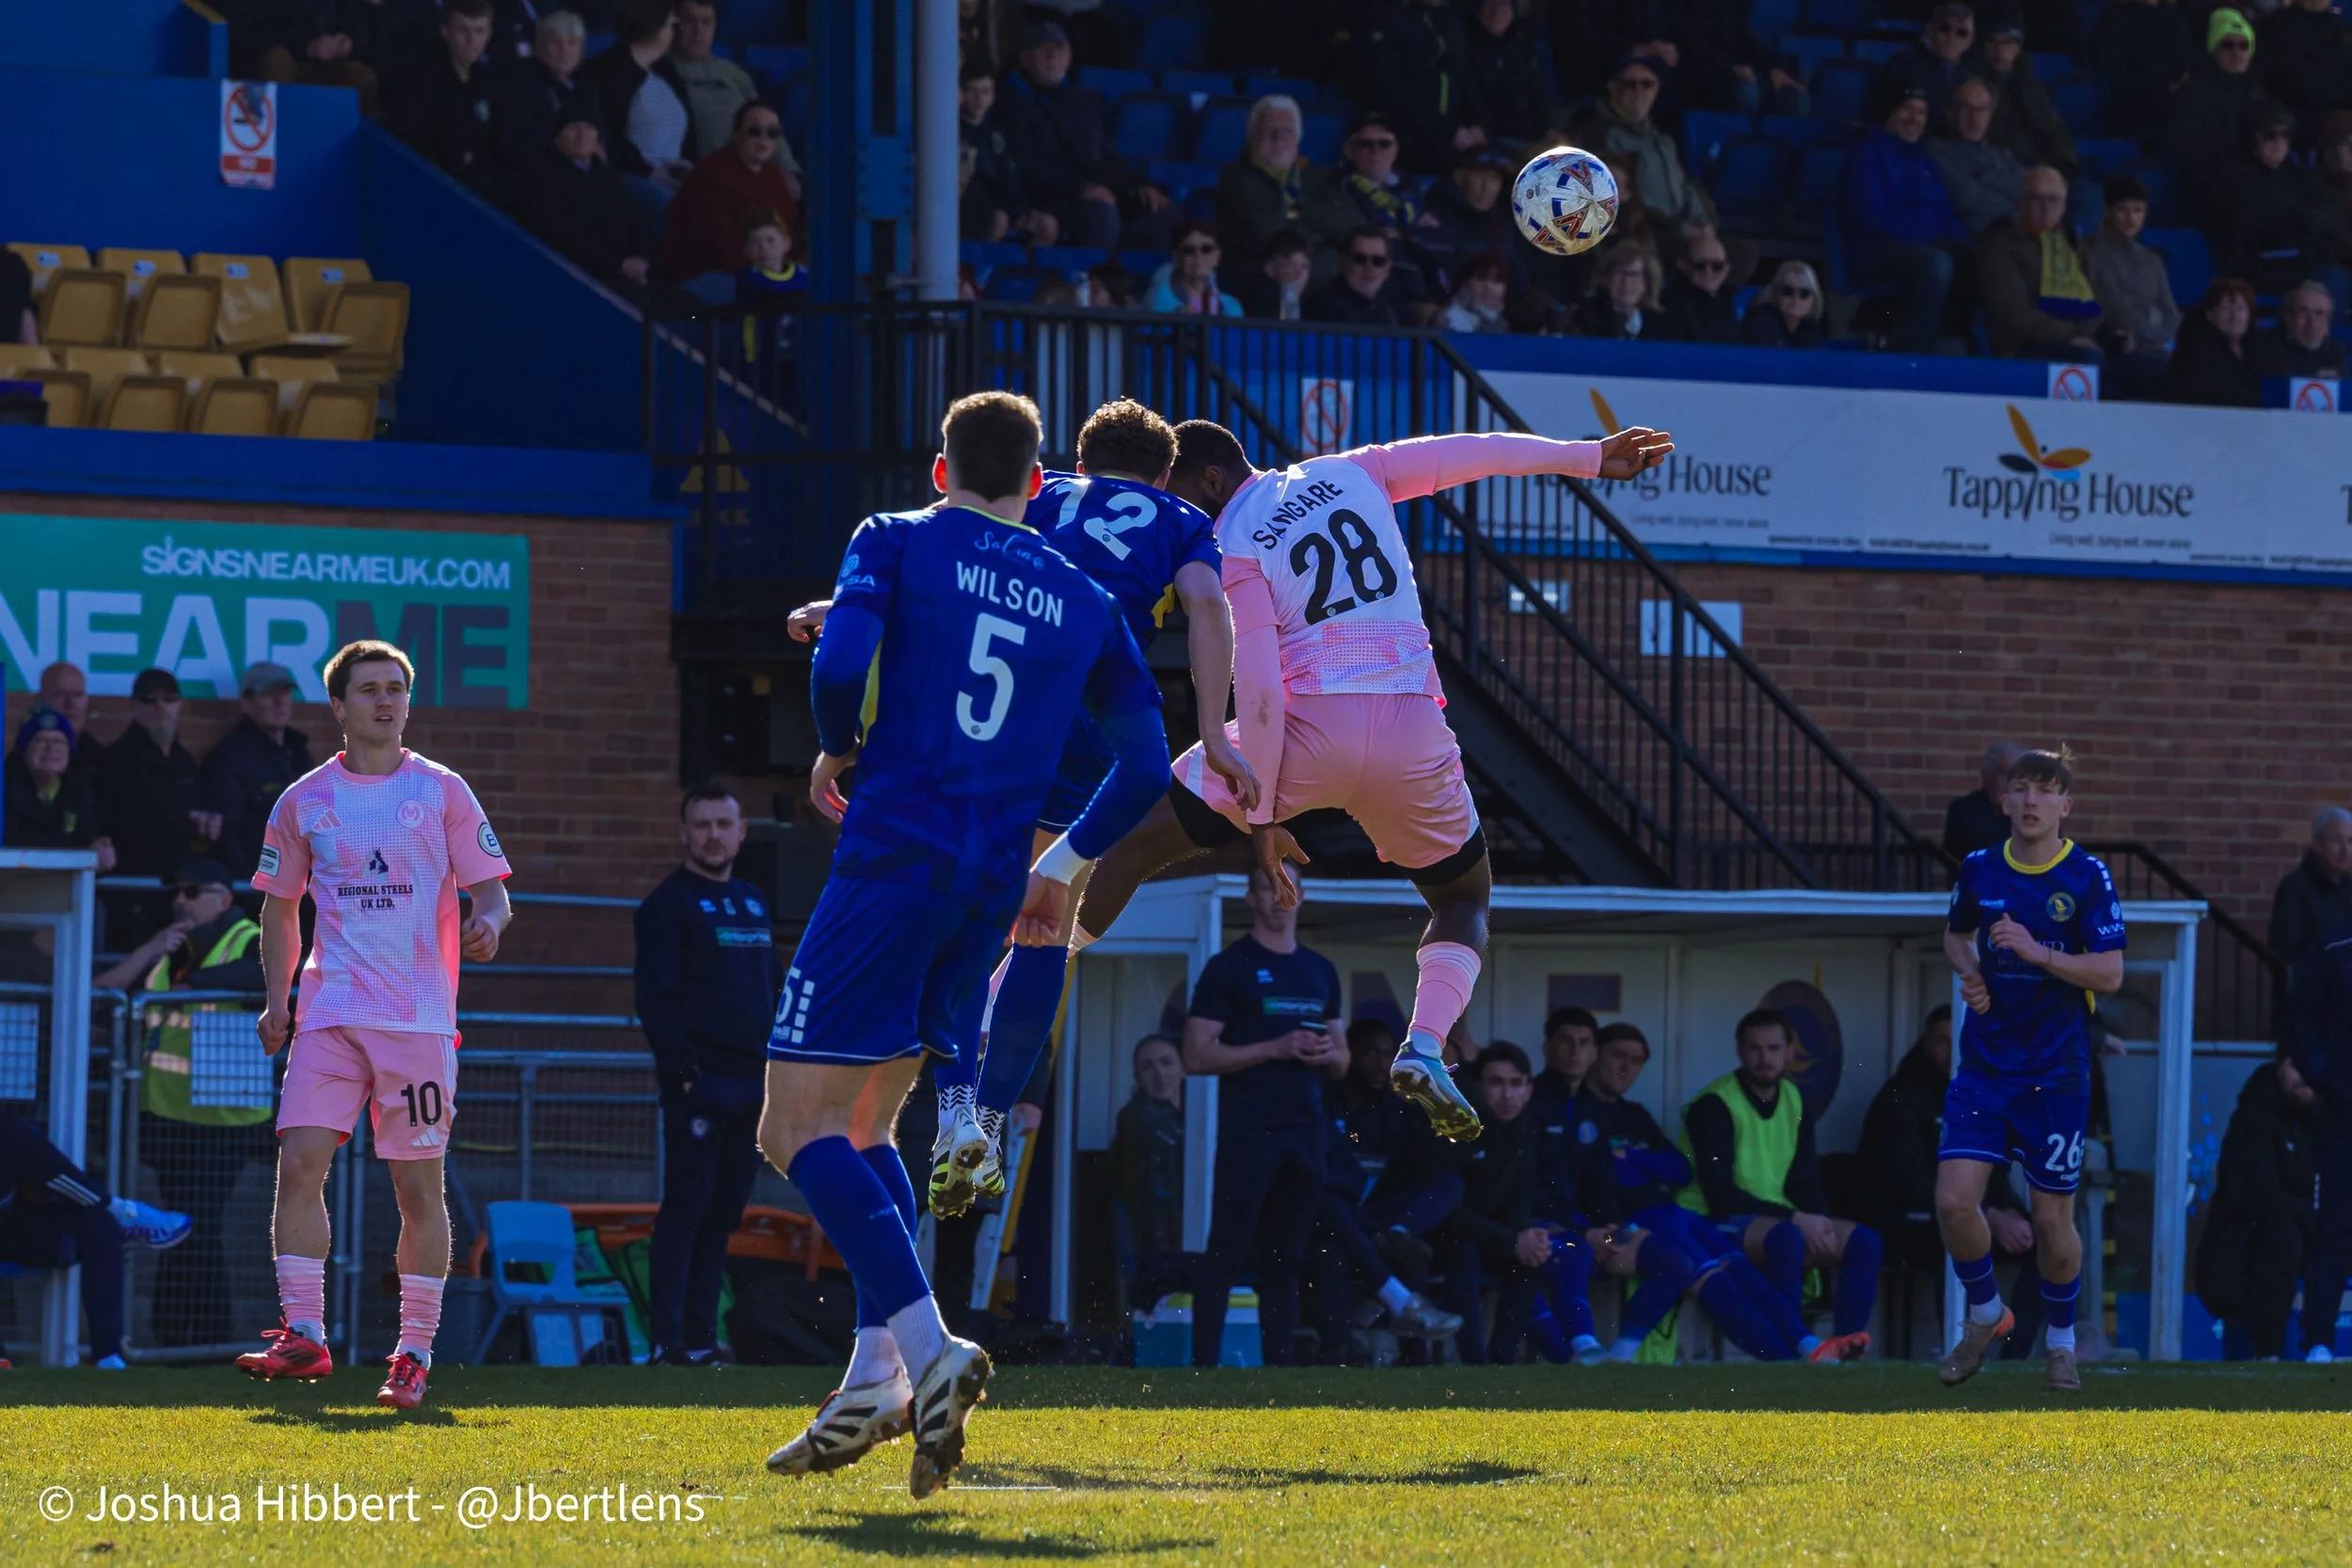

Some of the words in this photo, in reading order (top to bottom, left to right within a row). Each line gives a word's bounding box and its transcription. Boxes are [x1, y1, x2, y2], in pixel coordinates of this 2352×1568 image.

[1669, 453, 1772, 497] House
[1944, 467, 2082, 523] Tapping
[2088, 473, 2195, 517] House
[1252, 480, 1344, 550] SANGARE
[1289, 509, 1397, 626] 28
[956, 561, 1063, 627] WILSON
[956, 613, 1025, 741] 5
[338, 886, 379, 896] REGIONAL
[381, 884, 414, 895] STEELS
[360, 897, 373, 909] UK
[375, 897, 396, 909] LTD.
[400, 1080, 443, 1127] 10
[2045, 1131, 2080, 1172] 26
